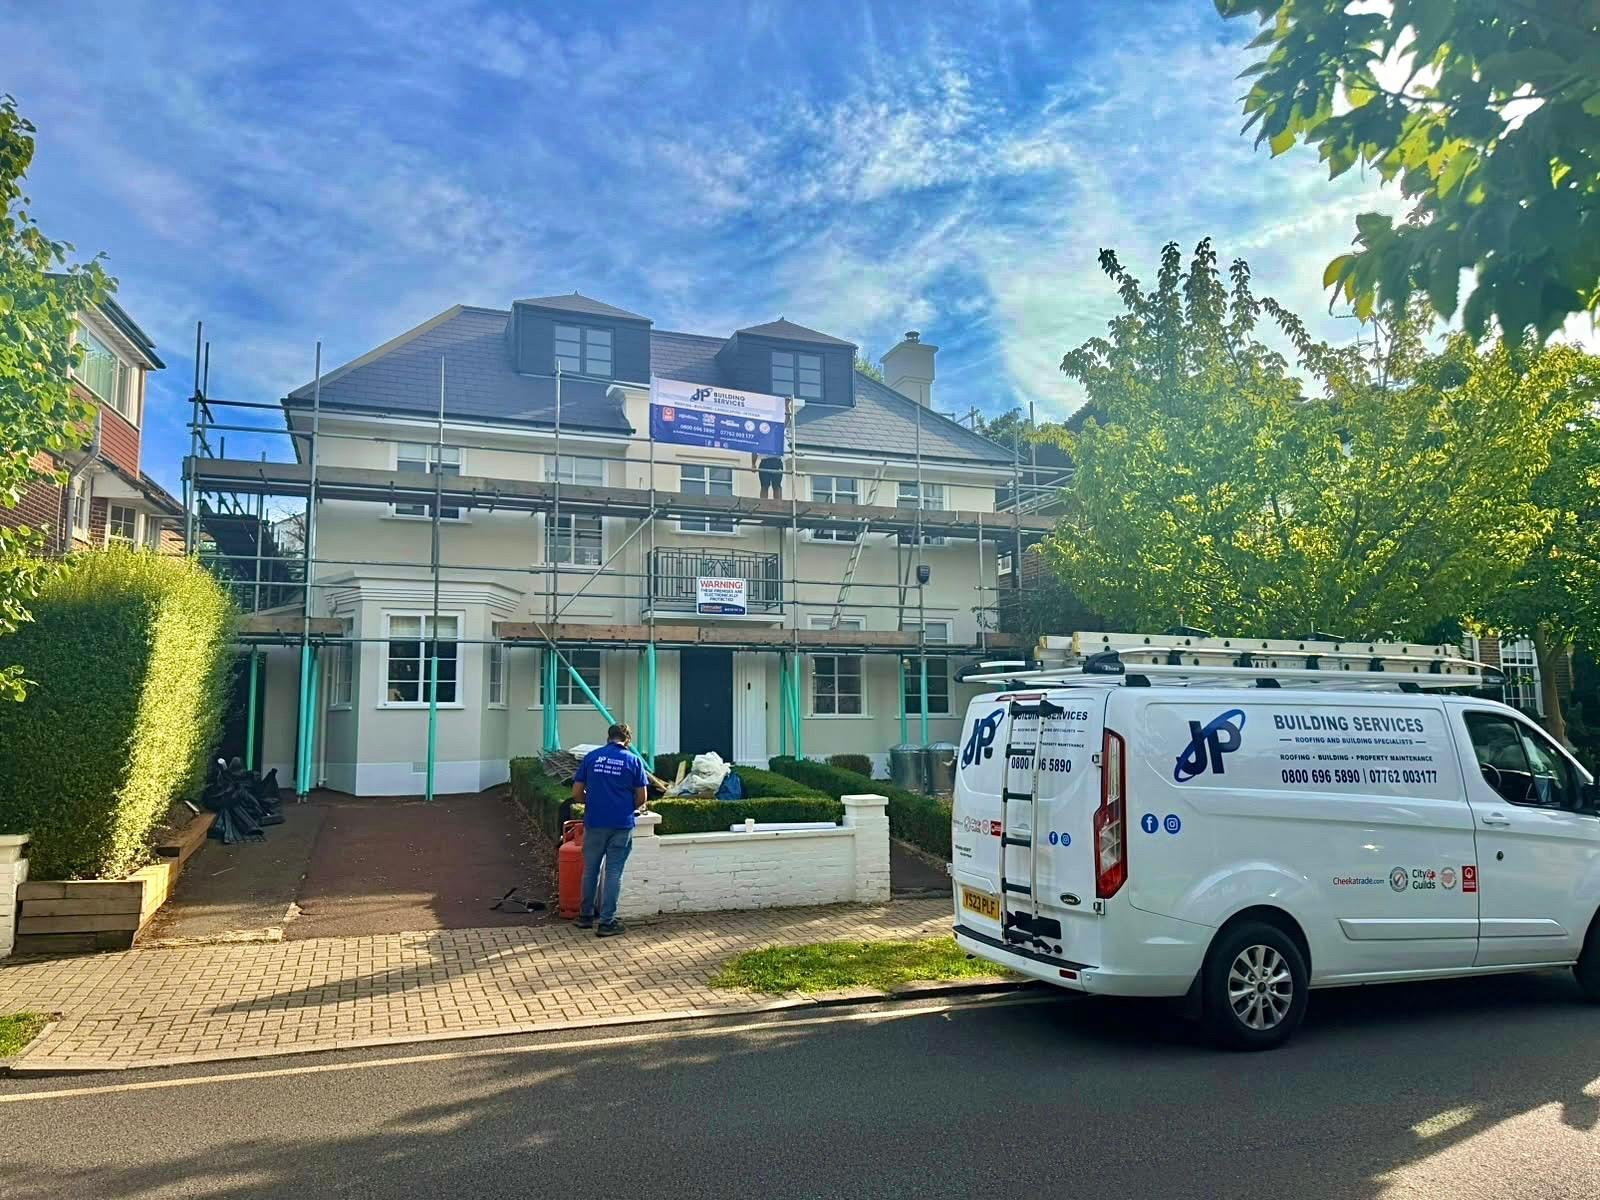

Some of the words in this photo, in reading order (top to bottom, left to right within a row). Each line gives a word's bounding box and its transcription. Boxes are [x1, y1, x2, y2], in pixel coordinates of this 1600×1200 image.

[714, 392, 745, 401] BUILDING
[714, 398, 745, 407] SERVICES
[700, 580, 743, 589] WARNING!
[1273, 714, 1349, 731] BUILDING
[1352, 716, 1424, 733] SERVICES
[1341, 737, 1373, 745] BUILDING
[1011, 757, 1029, 770] 0800
[1049, 758, 1072, 773] 5890
[1281, 768, 1309, 784] 0800
[1311, 769, 1332, 784] 696
[1334, 769, 1360, 784] 5890
[1369, 769, 1401, 784] 07762
[1402, 769, 1437, 784] 003177
[1412, 880, 1436, 890] Guilds
[964, 890, 981, 912] YS23
[981, 896, 996, 915] PLF
